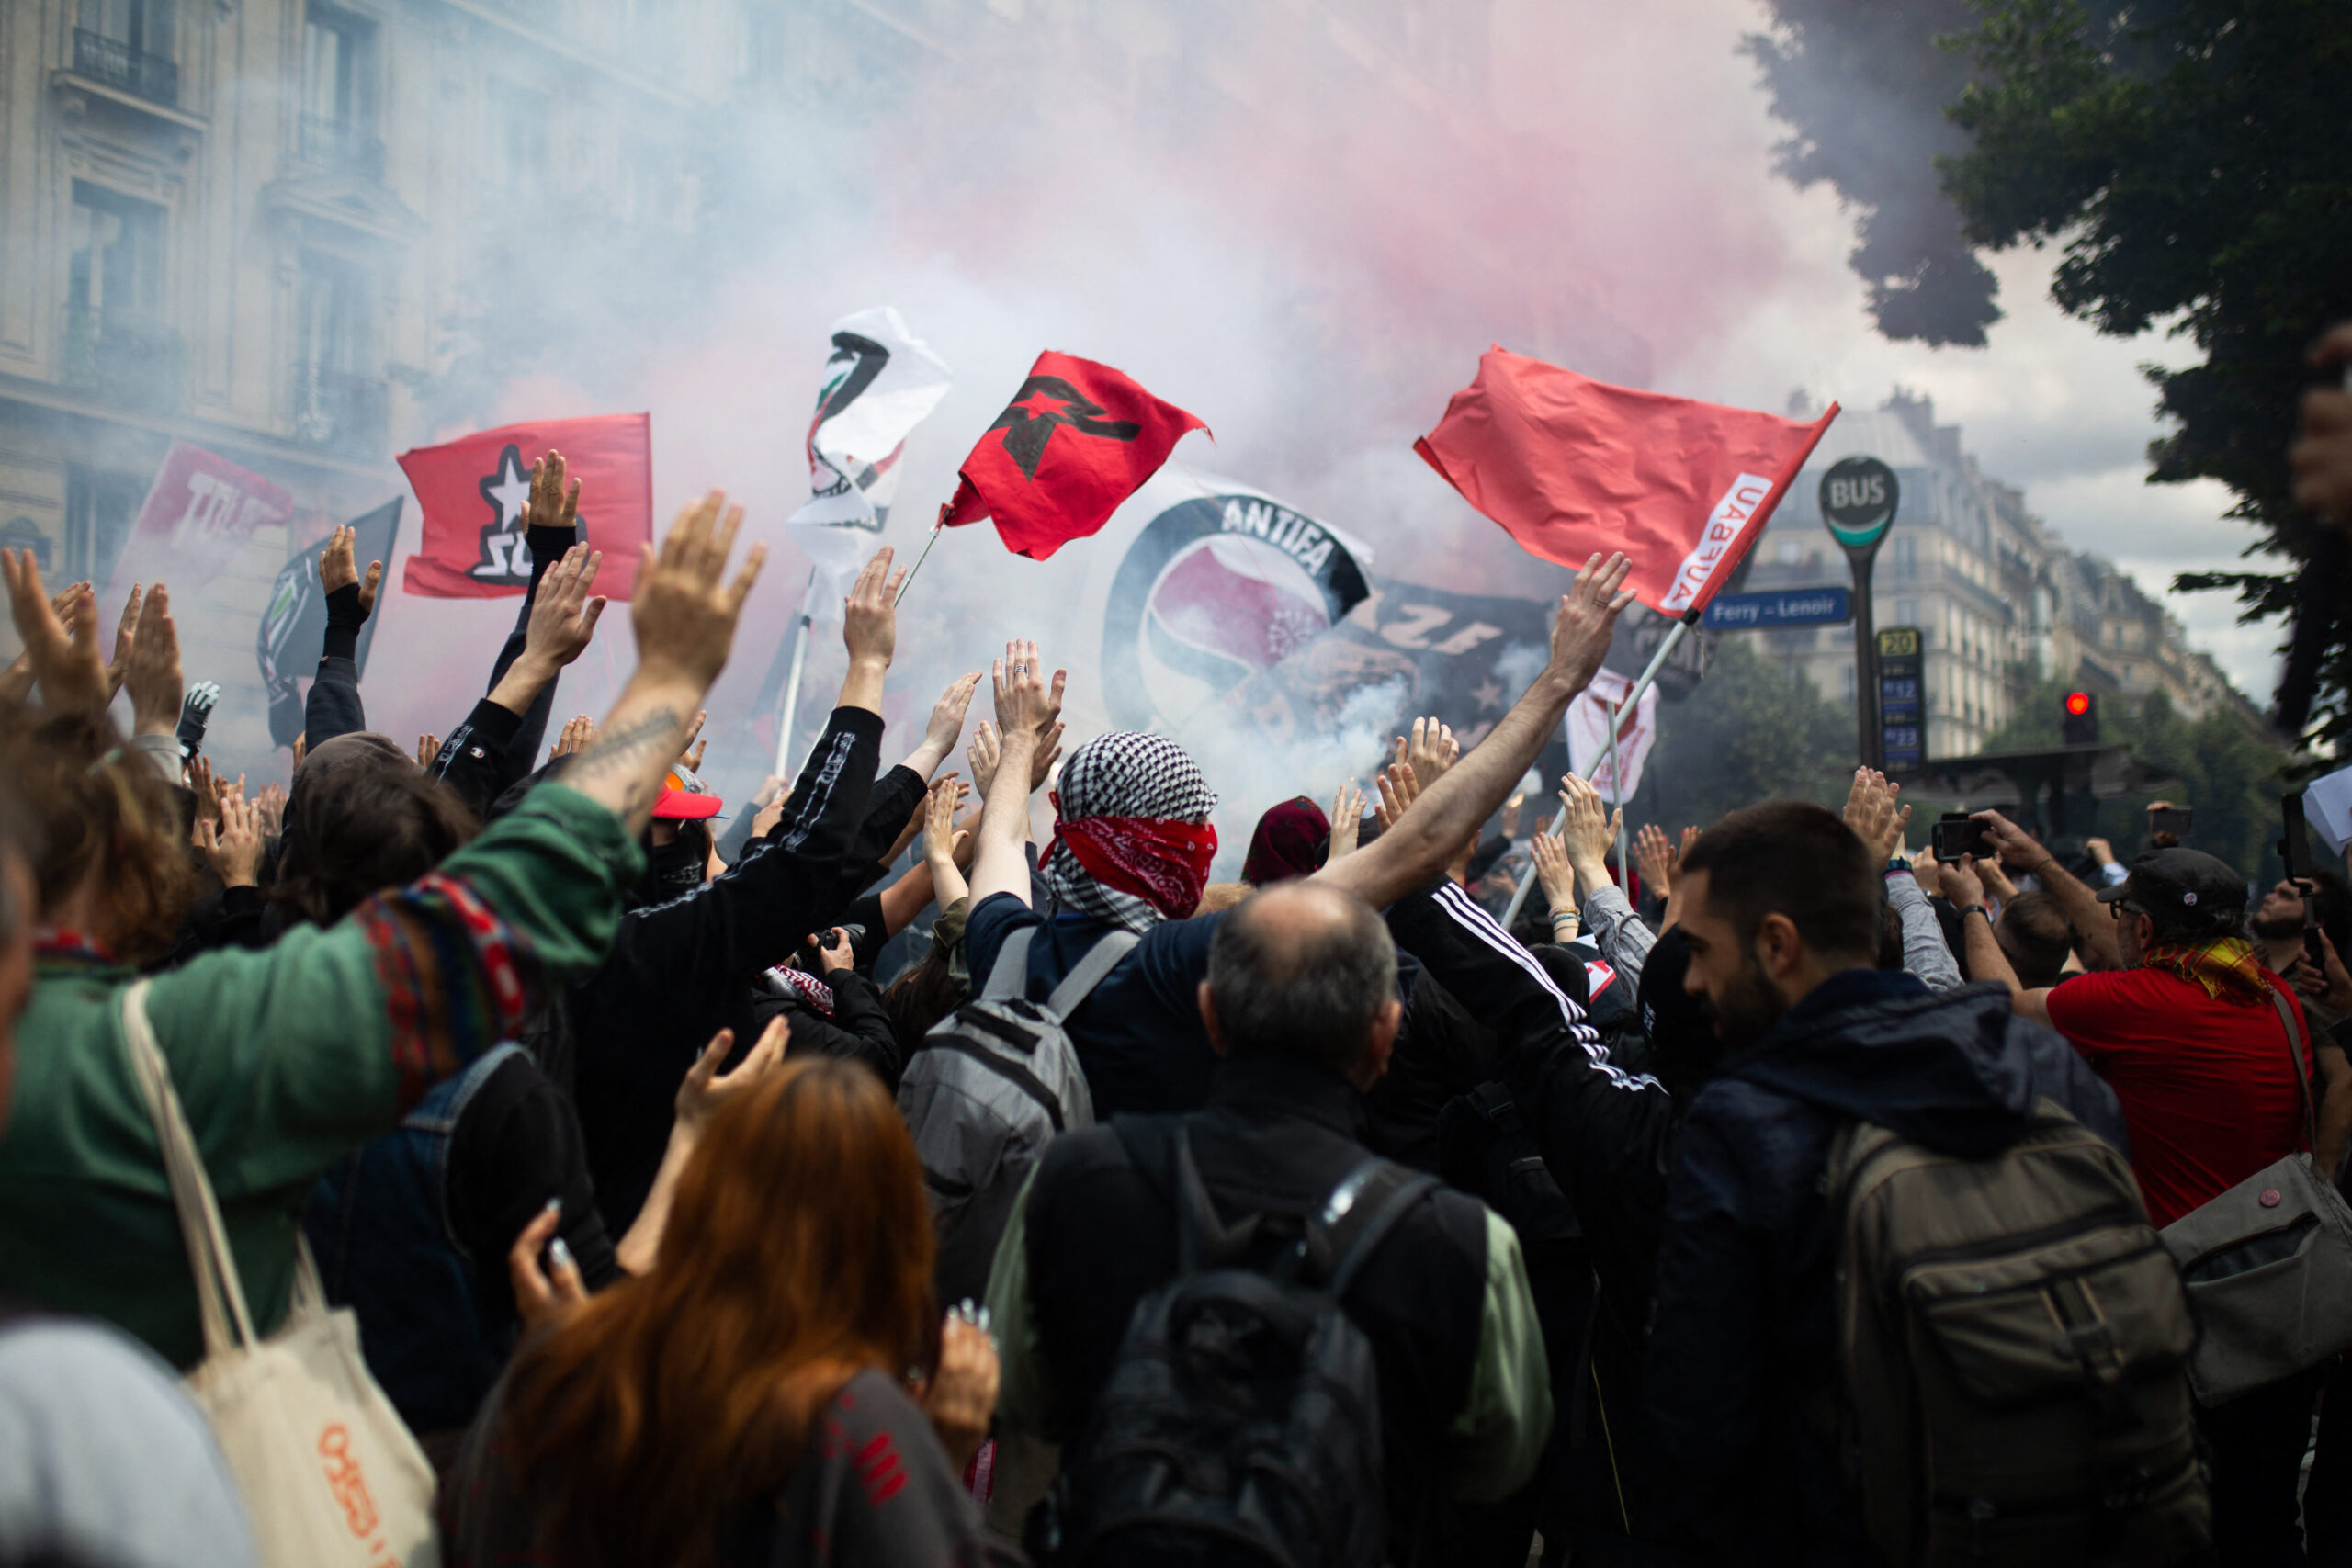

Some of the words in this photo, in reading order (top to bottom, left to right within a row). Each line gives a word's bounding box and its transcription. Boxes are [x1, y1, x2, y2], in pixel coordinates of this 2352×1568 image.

[1831, 475, 1885, 509] BUS
[1222, 499, 1334, 576] ANTIFA
[1713, 602, 1760, 623] Ferry
[1777, 597, 1836, 617] Lenoir
[1884, 635, 1912, 654] 20
